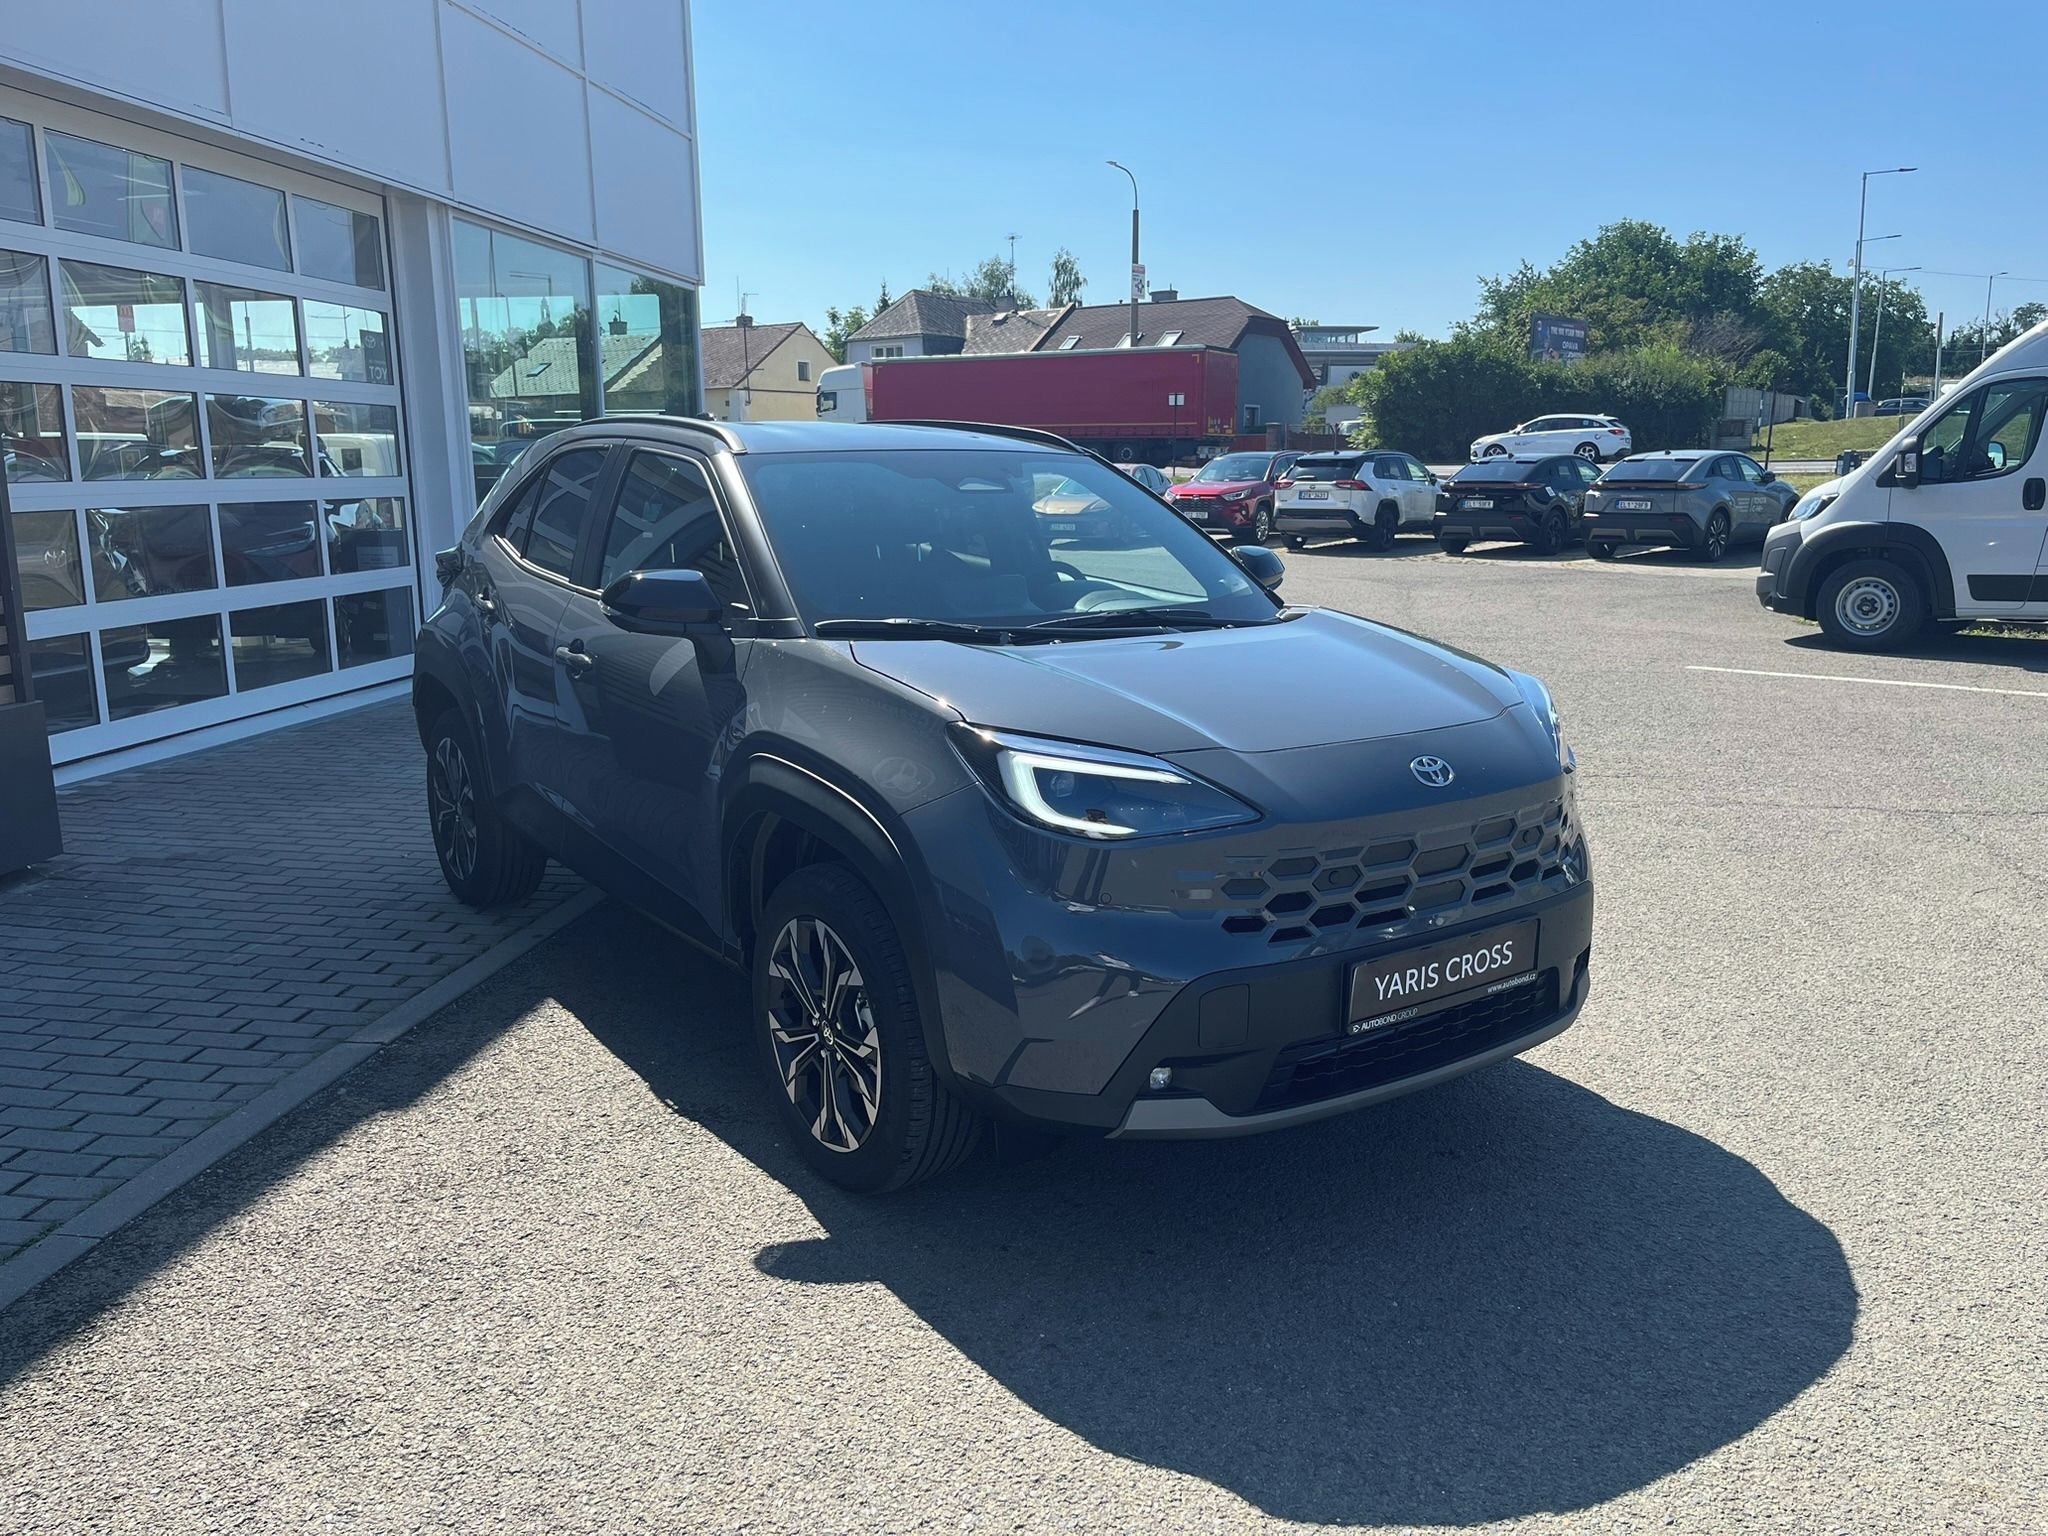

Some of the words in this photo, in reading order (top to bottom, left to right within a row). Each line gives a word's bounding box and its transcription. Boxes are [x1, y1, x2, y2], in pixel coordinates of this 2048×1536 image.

[1374, 963, 1439, 1000] YARIS
[1445, 941, 1513, 982] CROSS
[1487, 973, 1536, 993] www.autobond.cz
[1397, 1007, 1418, 1020] GROUP
